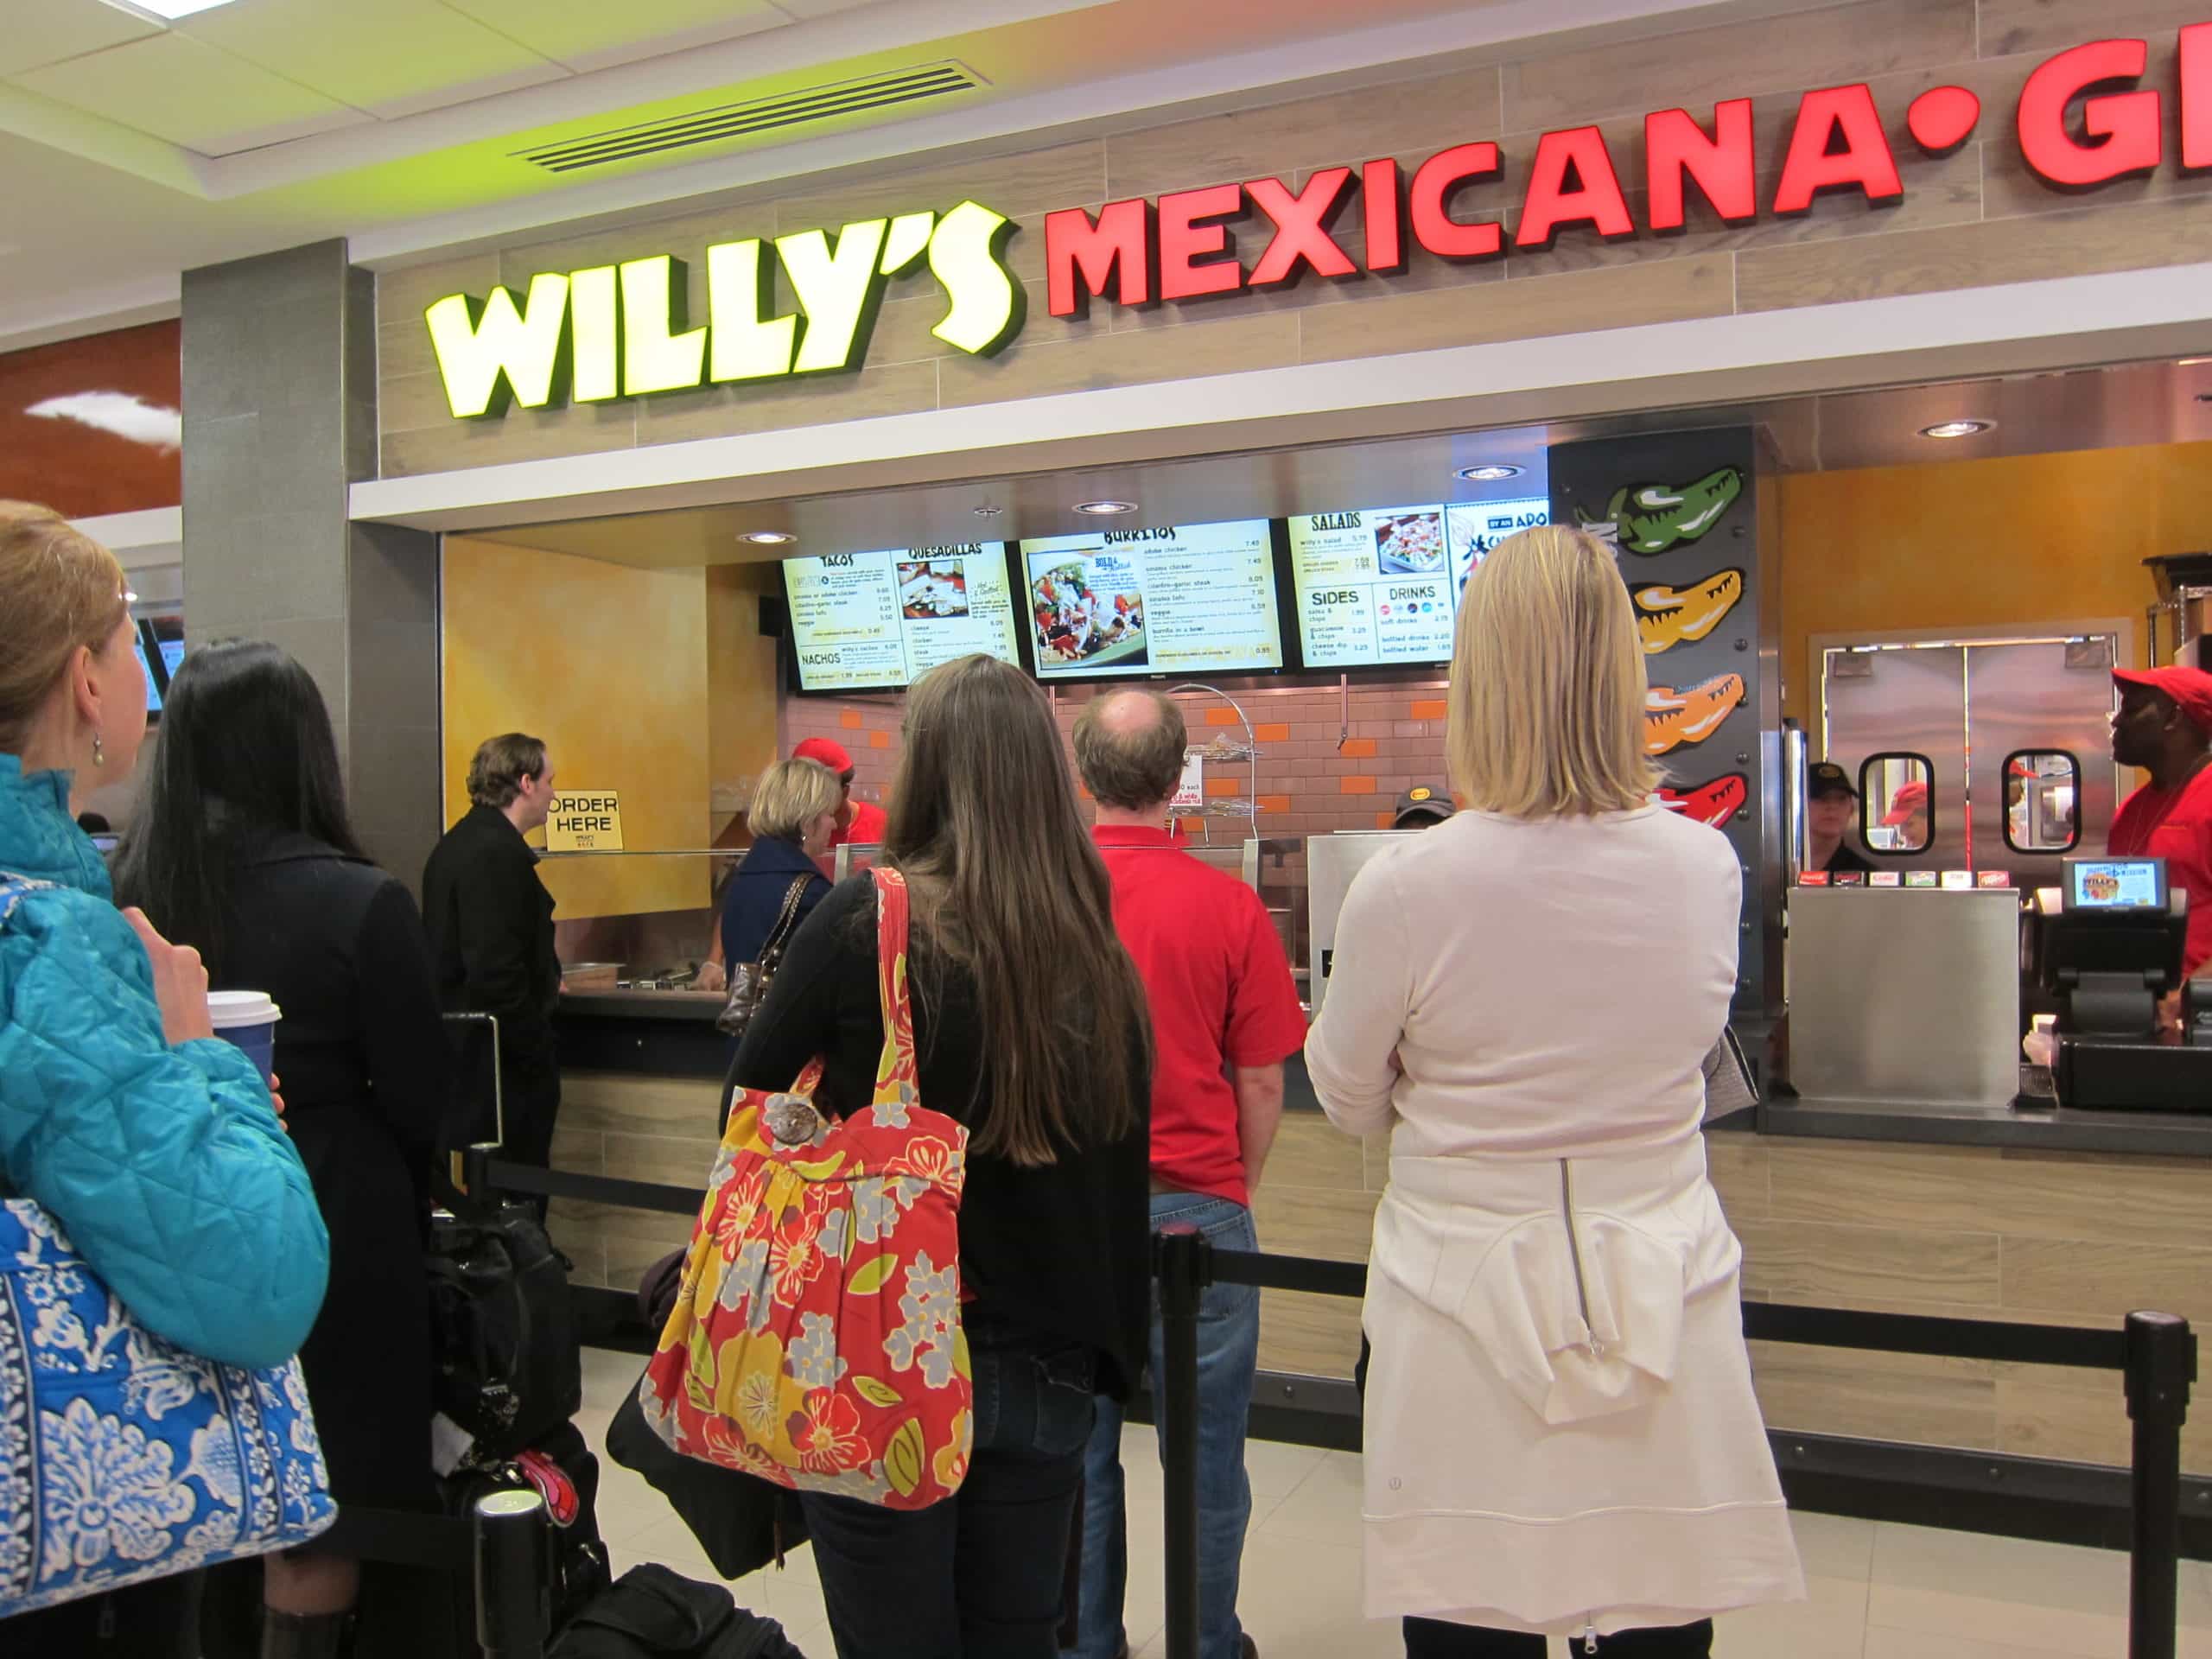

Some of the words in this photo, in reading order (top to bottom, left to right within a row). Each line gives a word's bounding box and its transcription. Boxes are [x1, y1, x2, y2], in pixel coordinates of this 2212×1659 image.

[424, 200, 1020, 419] WILLY'S
[1045, 84, 1902, 319] MEXICANA
[1312, 512, 1362, 531] SALADS
[1103, 527, 1176, 544] BURRITOS
[909, 543, 982, 559] QUESADILLAS
[820, 554, 854, 567] TACOS
[1312, 591, 1359, 606] SIDES
[1389, 586, 1436, 601] DRINKS
[802, 653, 841, 665] NACHOS
[548, 798, 617, 813] ORDER
[556, 817, 612, 831] HERE
